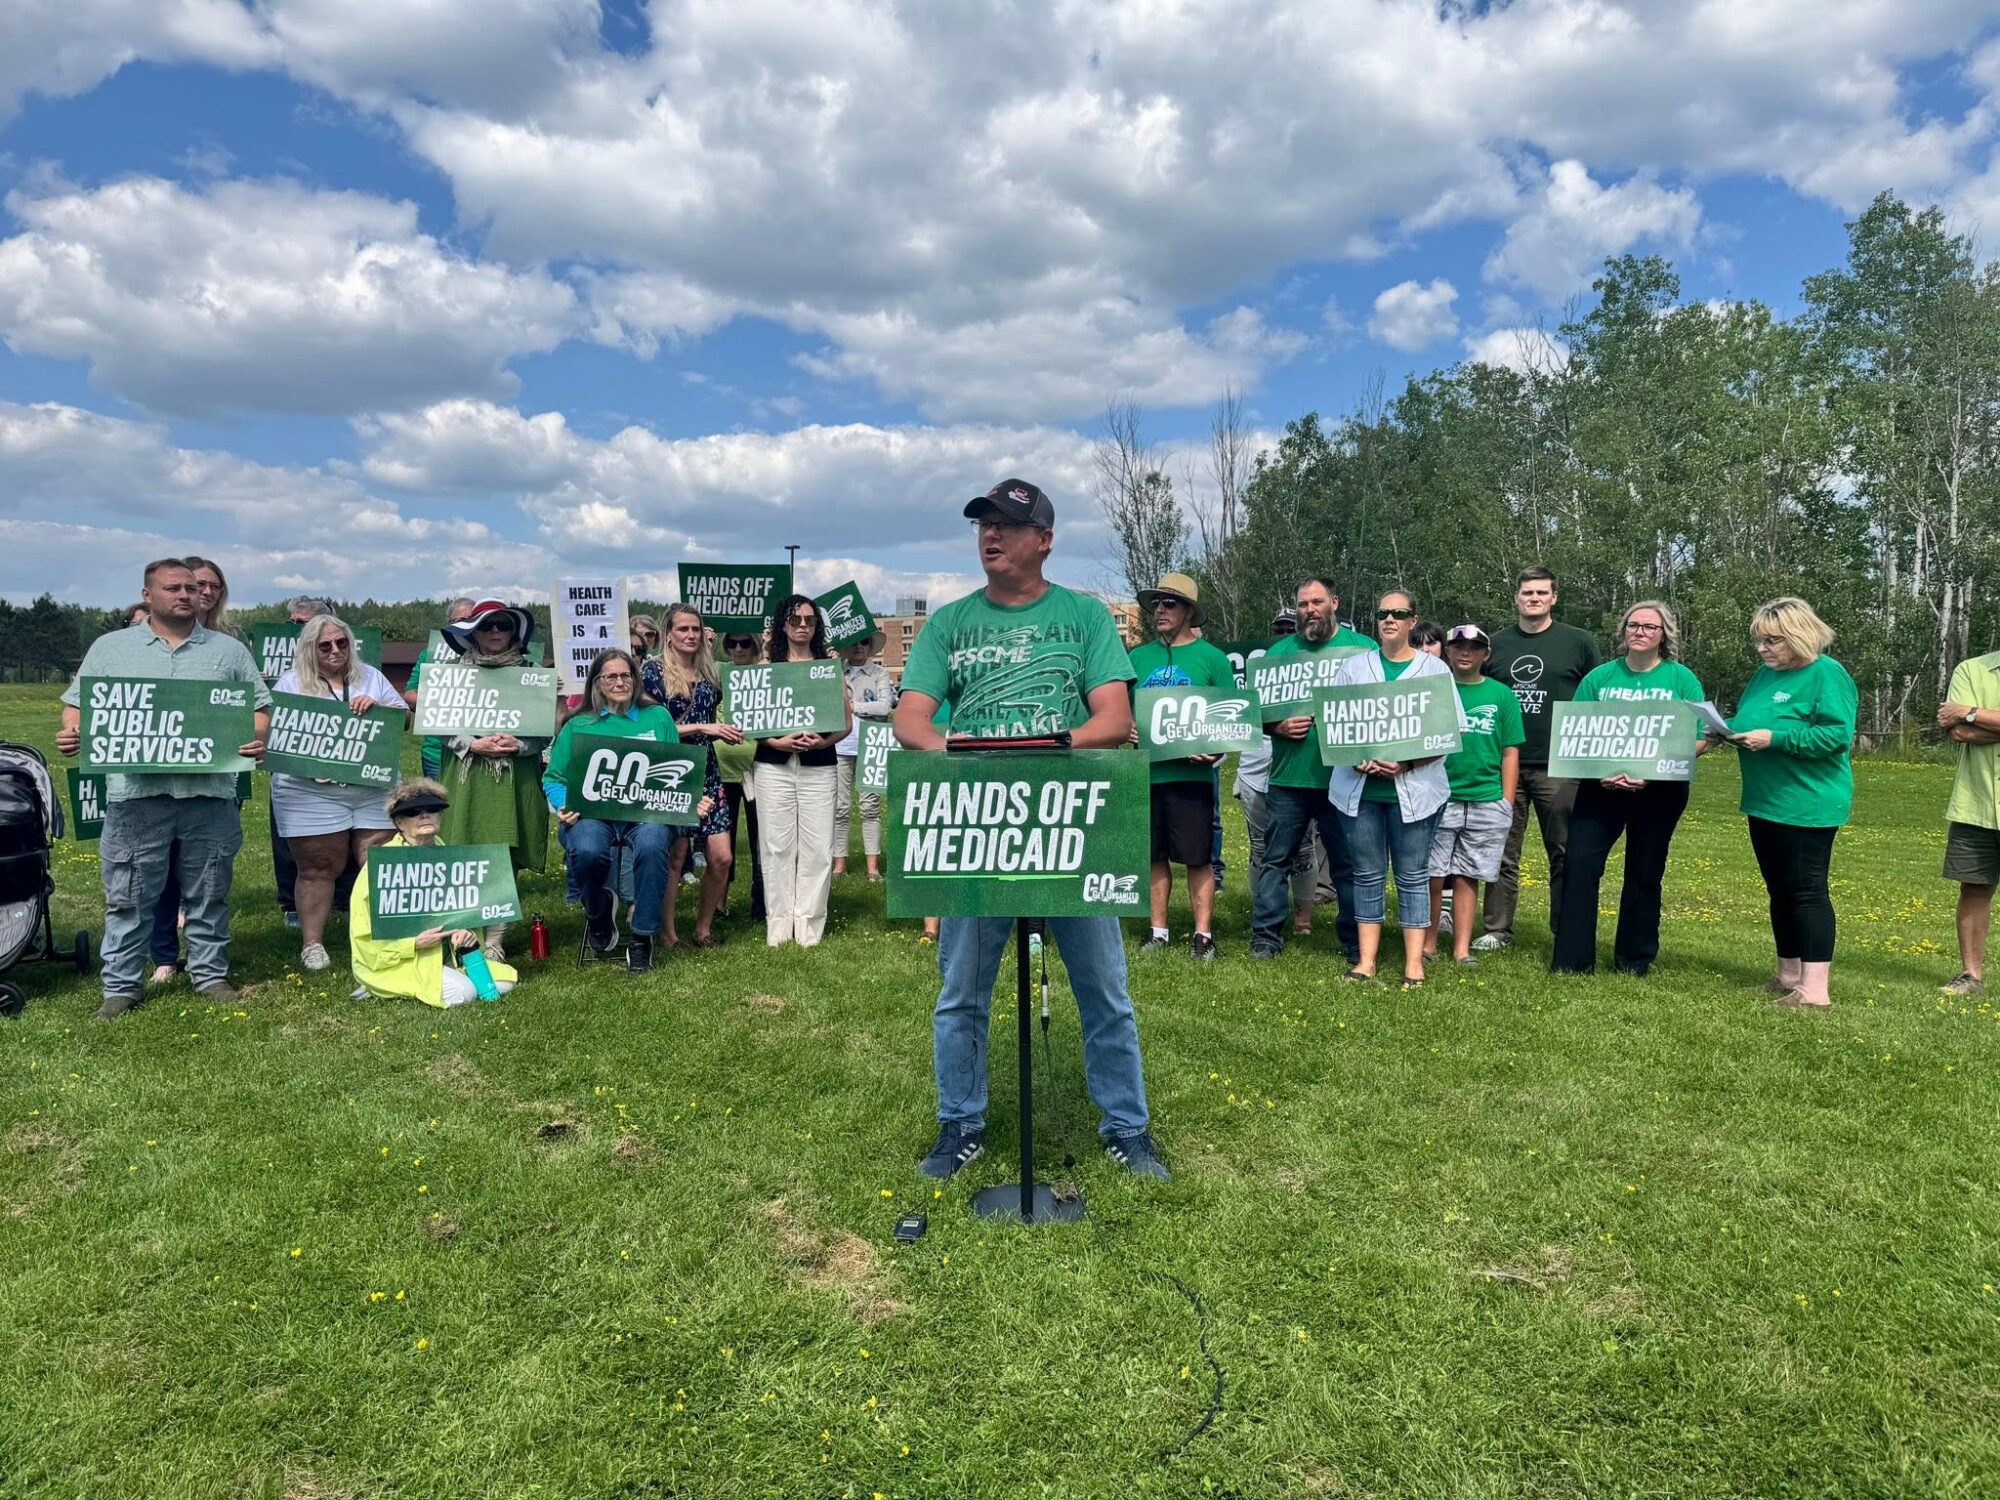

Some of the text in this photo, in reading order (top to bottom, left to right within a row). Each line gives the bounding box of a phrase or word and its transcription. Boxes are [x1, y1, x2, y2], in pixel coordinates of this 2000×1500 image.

[569, 587, 612, 600] HEALTH
[687, 576, 774, 596] HANDS OFF
[575, 603, 606, 616] CARE
[688, 595, 764, 615] MEDICAID
[572, 625, 608, 638] IS A
[825, 615, 865, 638] ORGANIZED
[263, 637, 299, 656] HAN
[572, 647, 601, 660] HUM
[427, 667, 479, 687] SAVE
[729, 668, 773, 690] SAVE
[1254, 661, 1315, 688] HANDS
[1317, 658, 1346, 677] OF
[90, 682, 156, 709] SAVE
[210, 689, 231, 705] GO
[424, 688, 499, 708] PUBLIC
[730, 687, 793, 711] PUBLIC
[1512, 690, 1547, 703] EXT
[1608, 687, 1673, 701] HEALTH
[1323, 690, 1432, 723] HANDS OFF
[90, 710, 184, 736] PUBLIC
[270, 706, 384, 742] HANDS OFF
[423, 708, 522, 729] SERVICES
[731, 706, 815, 731] SERVICES
[982, 713, 1066, 737] MAKE
[1150, 695, 1207, 745] GO
[1166, 720, 1252, 739] GET ORGANIZED
[1560, 715, 1675, 737] HANDS OFF
[865, 726, 902, 747] SAV
[1208, 733, 1251, 742] AFSCME
[1326, 715, 1422, 745] MEDICAID
[90, 737, 214, 763] SERVICES
[268, 729, 367, 762] MEDICAID
[1558, 736, 1660, 758] MEDICAID
[582, 748, 650, 804] GO
[601, 779, 692, 805] GET ORGANIZED
[903, 781, 1111, 825] HANDS OFF
[643, 802, 689, 813] AFSCME
[903, 828, 1085, 872] MEDICAID
[377, 860, 490, 888] HANDS OFF
[1083, 873, 1115, 902] GO
[378, 885, 479, 915] MEDICAID
